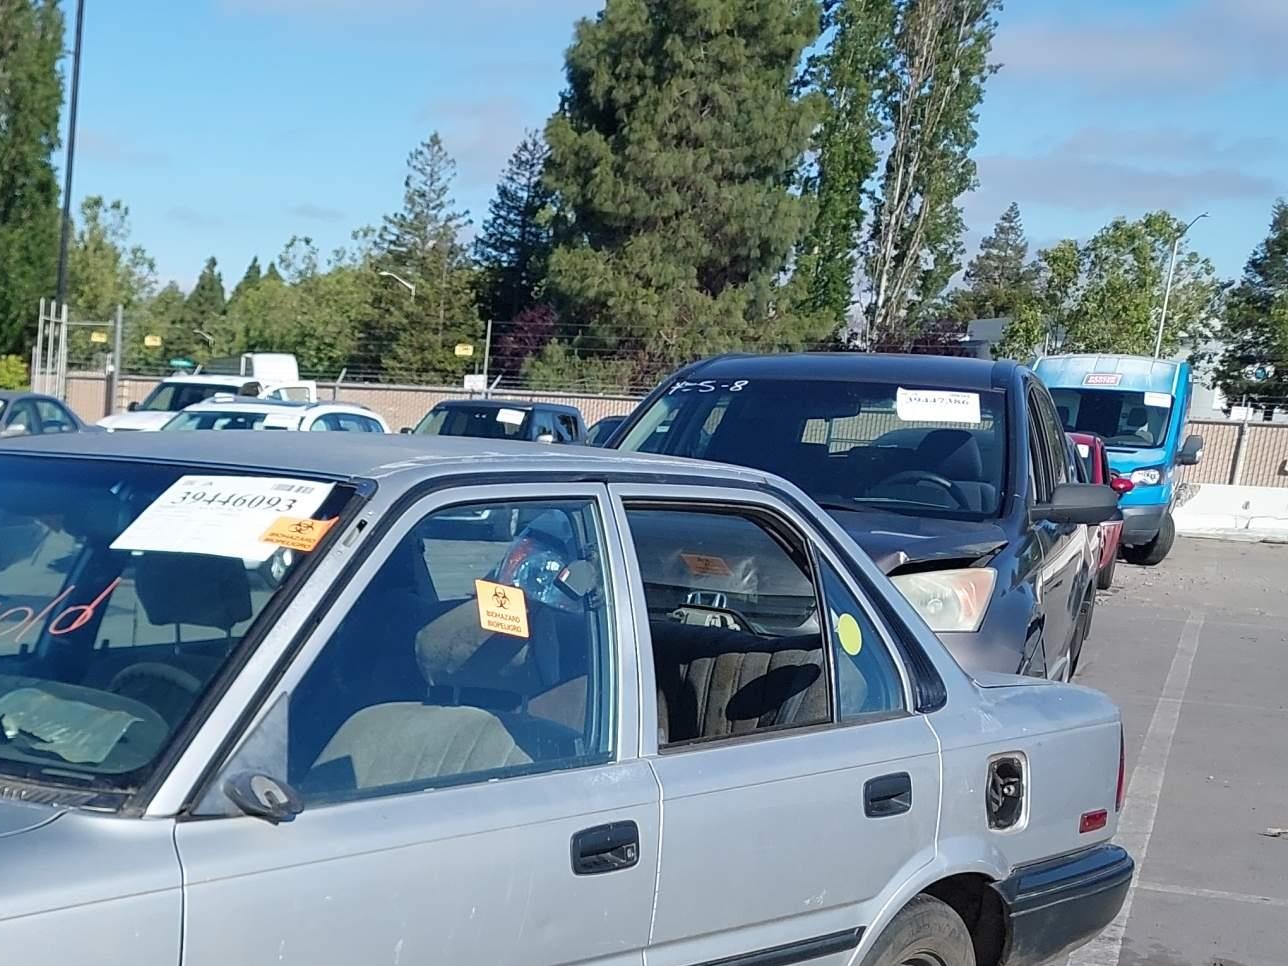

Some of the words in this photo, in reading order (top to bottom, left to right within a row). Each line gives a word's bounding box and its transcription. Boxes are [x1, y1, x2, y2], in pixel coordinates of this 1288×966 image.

[170, 491, 297, 512] 39446093
[486, 610, 521, 624] BIOHAZARD
[487, 620, 522, 633] BIOPELIGRO
